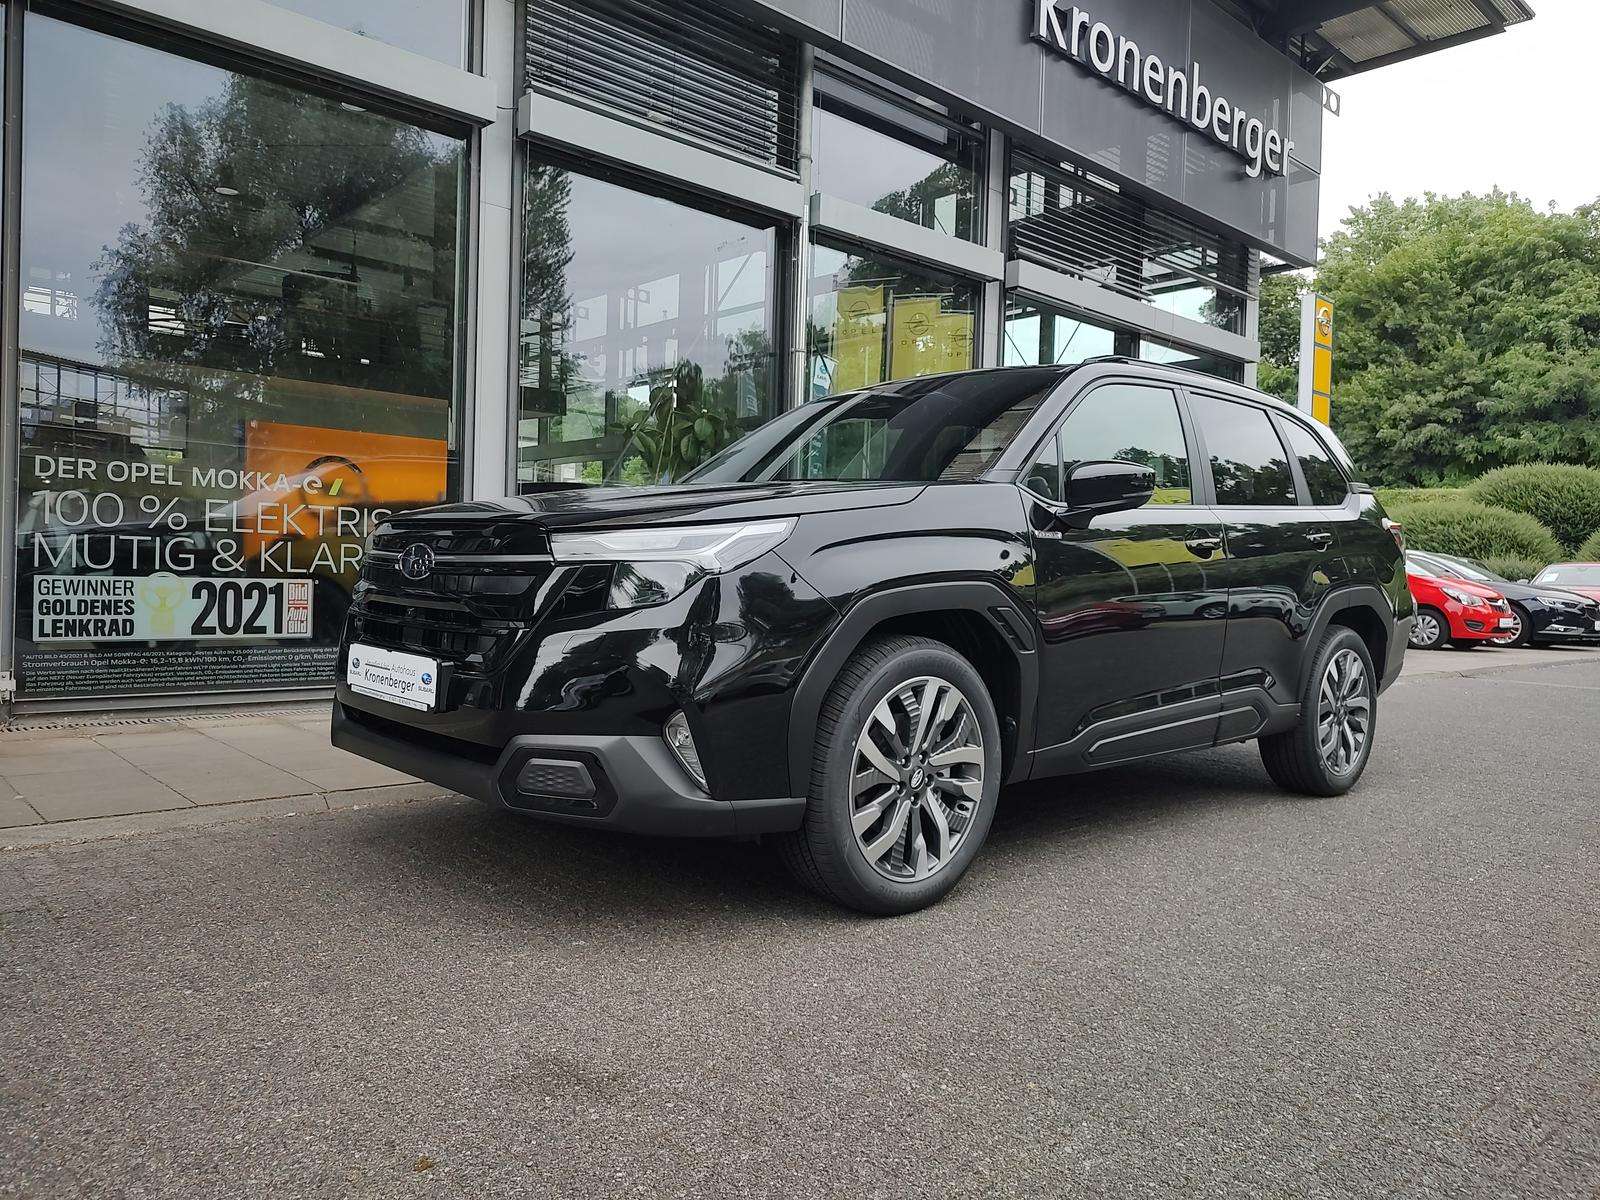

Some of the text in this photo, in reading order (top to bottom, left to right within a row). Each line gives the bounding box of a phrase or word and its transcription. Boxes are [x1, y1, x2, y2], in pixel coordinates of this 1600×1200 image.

[1040, 0, 1294, 177] Kronenberger
[34, 455, 323, 495] DER OPEL MOKKA-e
[32, 489, 124, 528] 100
[139, 494, 188, 531] %
[33, 532, 363, 574] MUTIG & KLAR
[38, 578, 135, 597] GEWINNER
[38, 599, 135, 616] GOLDENES
[191, 580, 284, 636] 2021
[38, 618, 135, 638] LENKRAD
[22, 659, 89, 668] Stromverbrauch
[91, 659, 109, 667] Opel
[364, 668, 415, 694] Kronenberger
